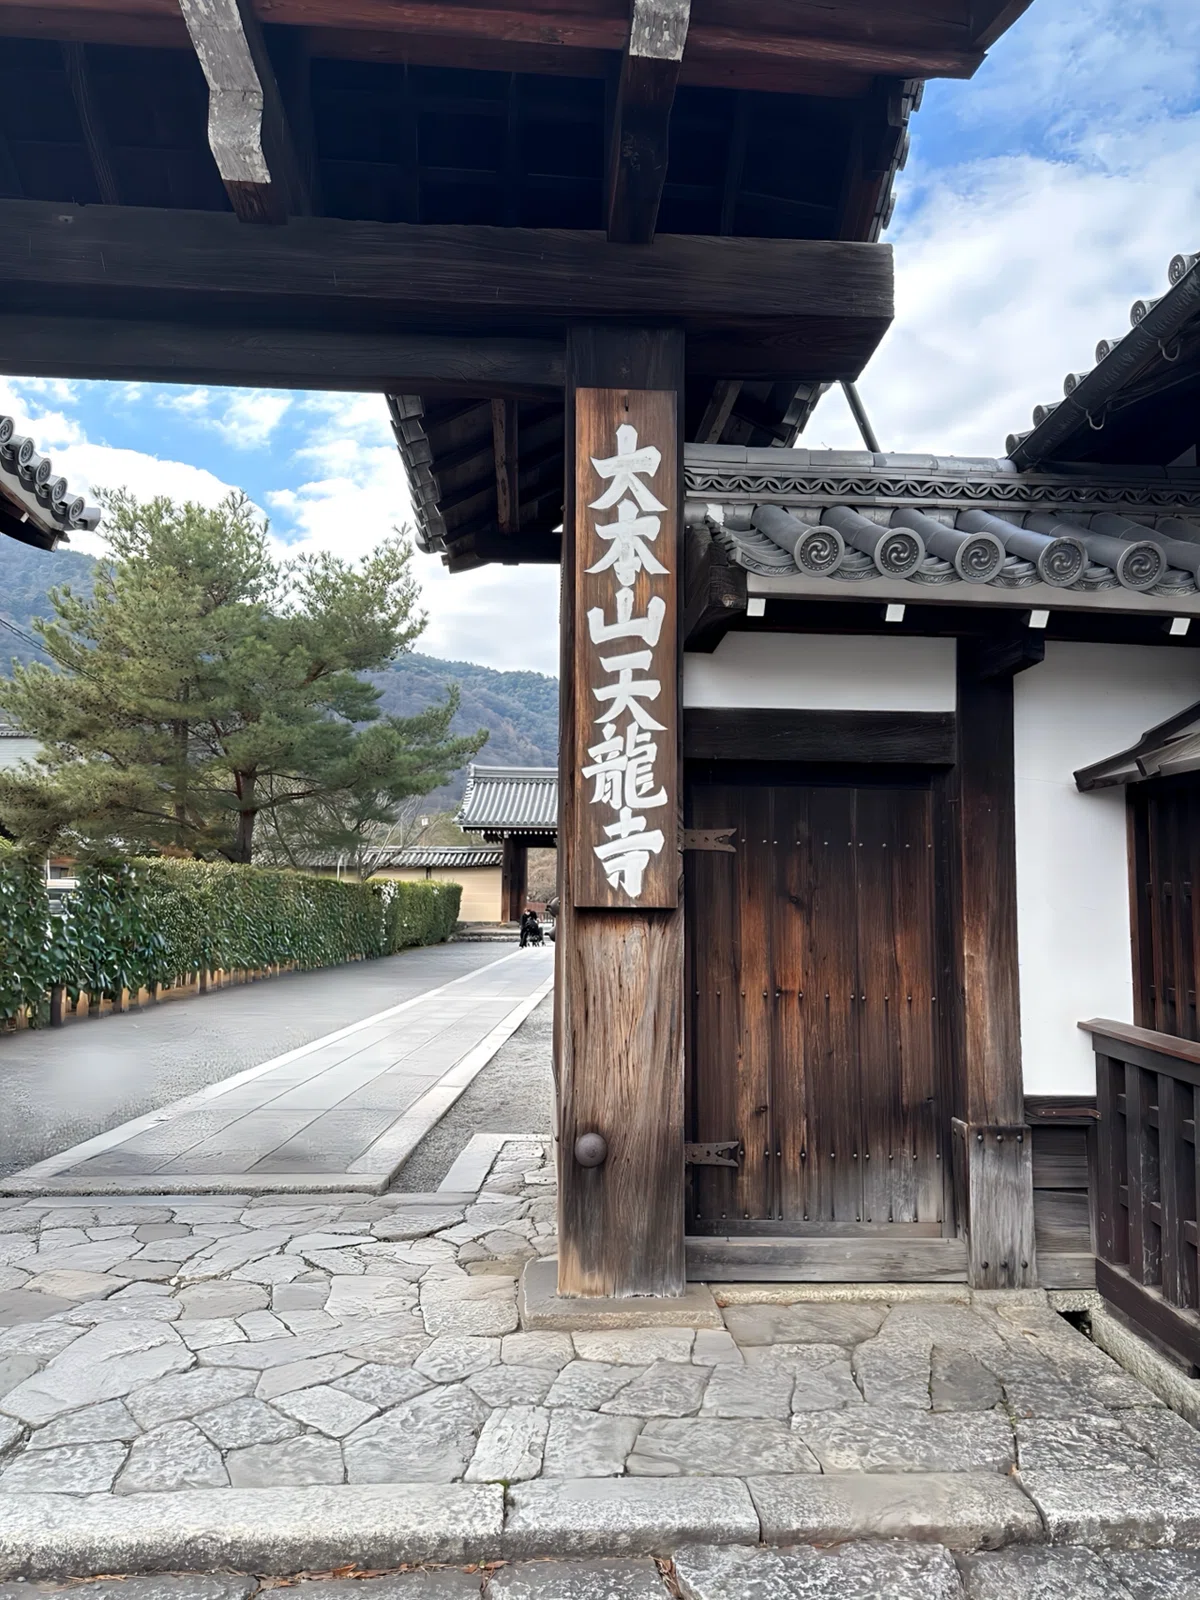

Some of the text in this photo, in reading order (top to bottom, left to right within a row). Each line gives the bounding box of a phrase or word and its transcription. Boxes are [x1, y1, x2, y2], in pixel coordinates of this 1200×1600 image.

[582, 423, 671, 899] 大本山天龍寺
